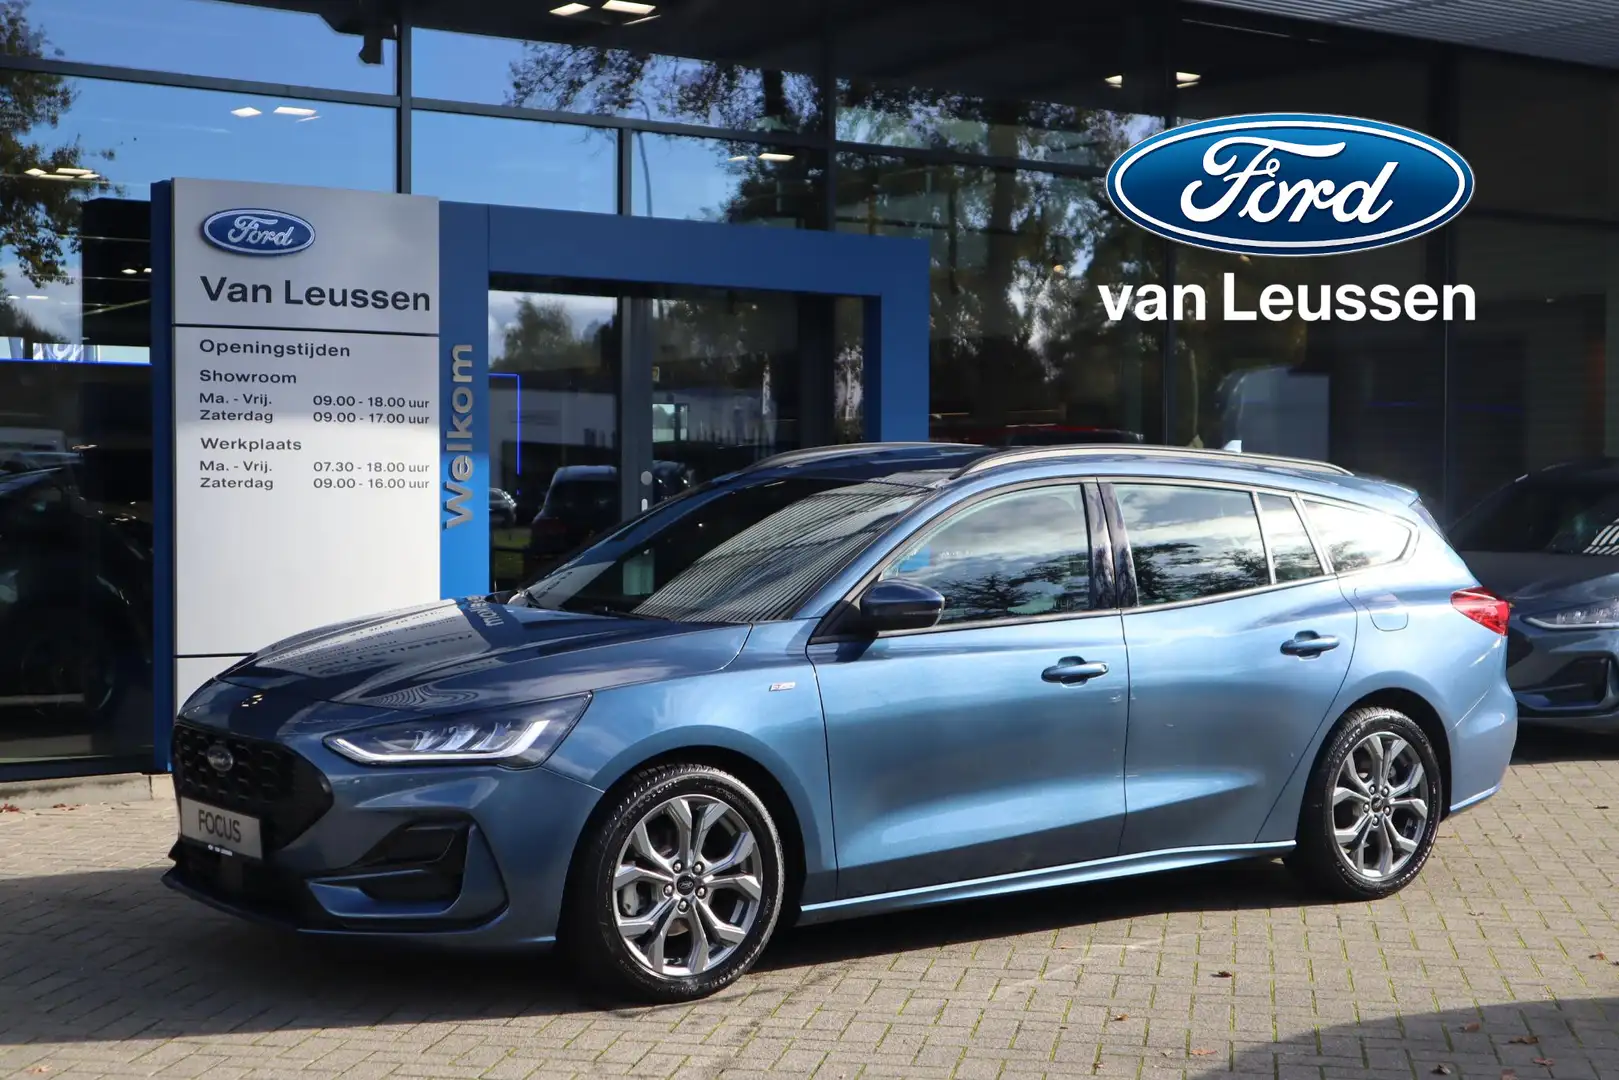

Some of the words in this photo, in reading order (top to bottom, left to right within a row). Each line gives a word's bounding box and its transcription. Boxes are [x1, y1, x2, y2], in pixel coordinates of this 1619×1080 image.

[227, 215, 295, 246] Ford
[199, 275, 273, 304] Van
[284, 279, 431, 312] Leussen
[199, 338, 351, 358] Openingstijden
[199, 369, 298, 384] Showroom
[199, 392, 229, 405] Ma.
[242, 393, 273, 408] Vrij.
[312, 394, 356, 407] 09.00
[367, 396, 406, 409] 18.00
[408, 398, 430, 409] uur
[199, 409, 274, 424] Zaterdag
[312, 411, 357, 424] 09.00
[368, 412, 406, 425] 17.00
[408, 414, 430, 425] uur
[446, 344, 474, 528] Welkom
[200, 437, 302, 453] Werkplaats
[199, 460, 230, 473] Ma.
[242, 460, 273, 475] Vrij.
[312, 461, 355, 474] 07.30
[366, 461, 406, 474] 18.00
[408, 463, 430, 473] uur
[199, 476, 274, 491] Zaterdag
[312, 477, 356, 490] 09.00
[367, 477, 406, 490] 16.00
[408, 479, 430, 490] uur
[198, 809, 242, 843] FOCUS
